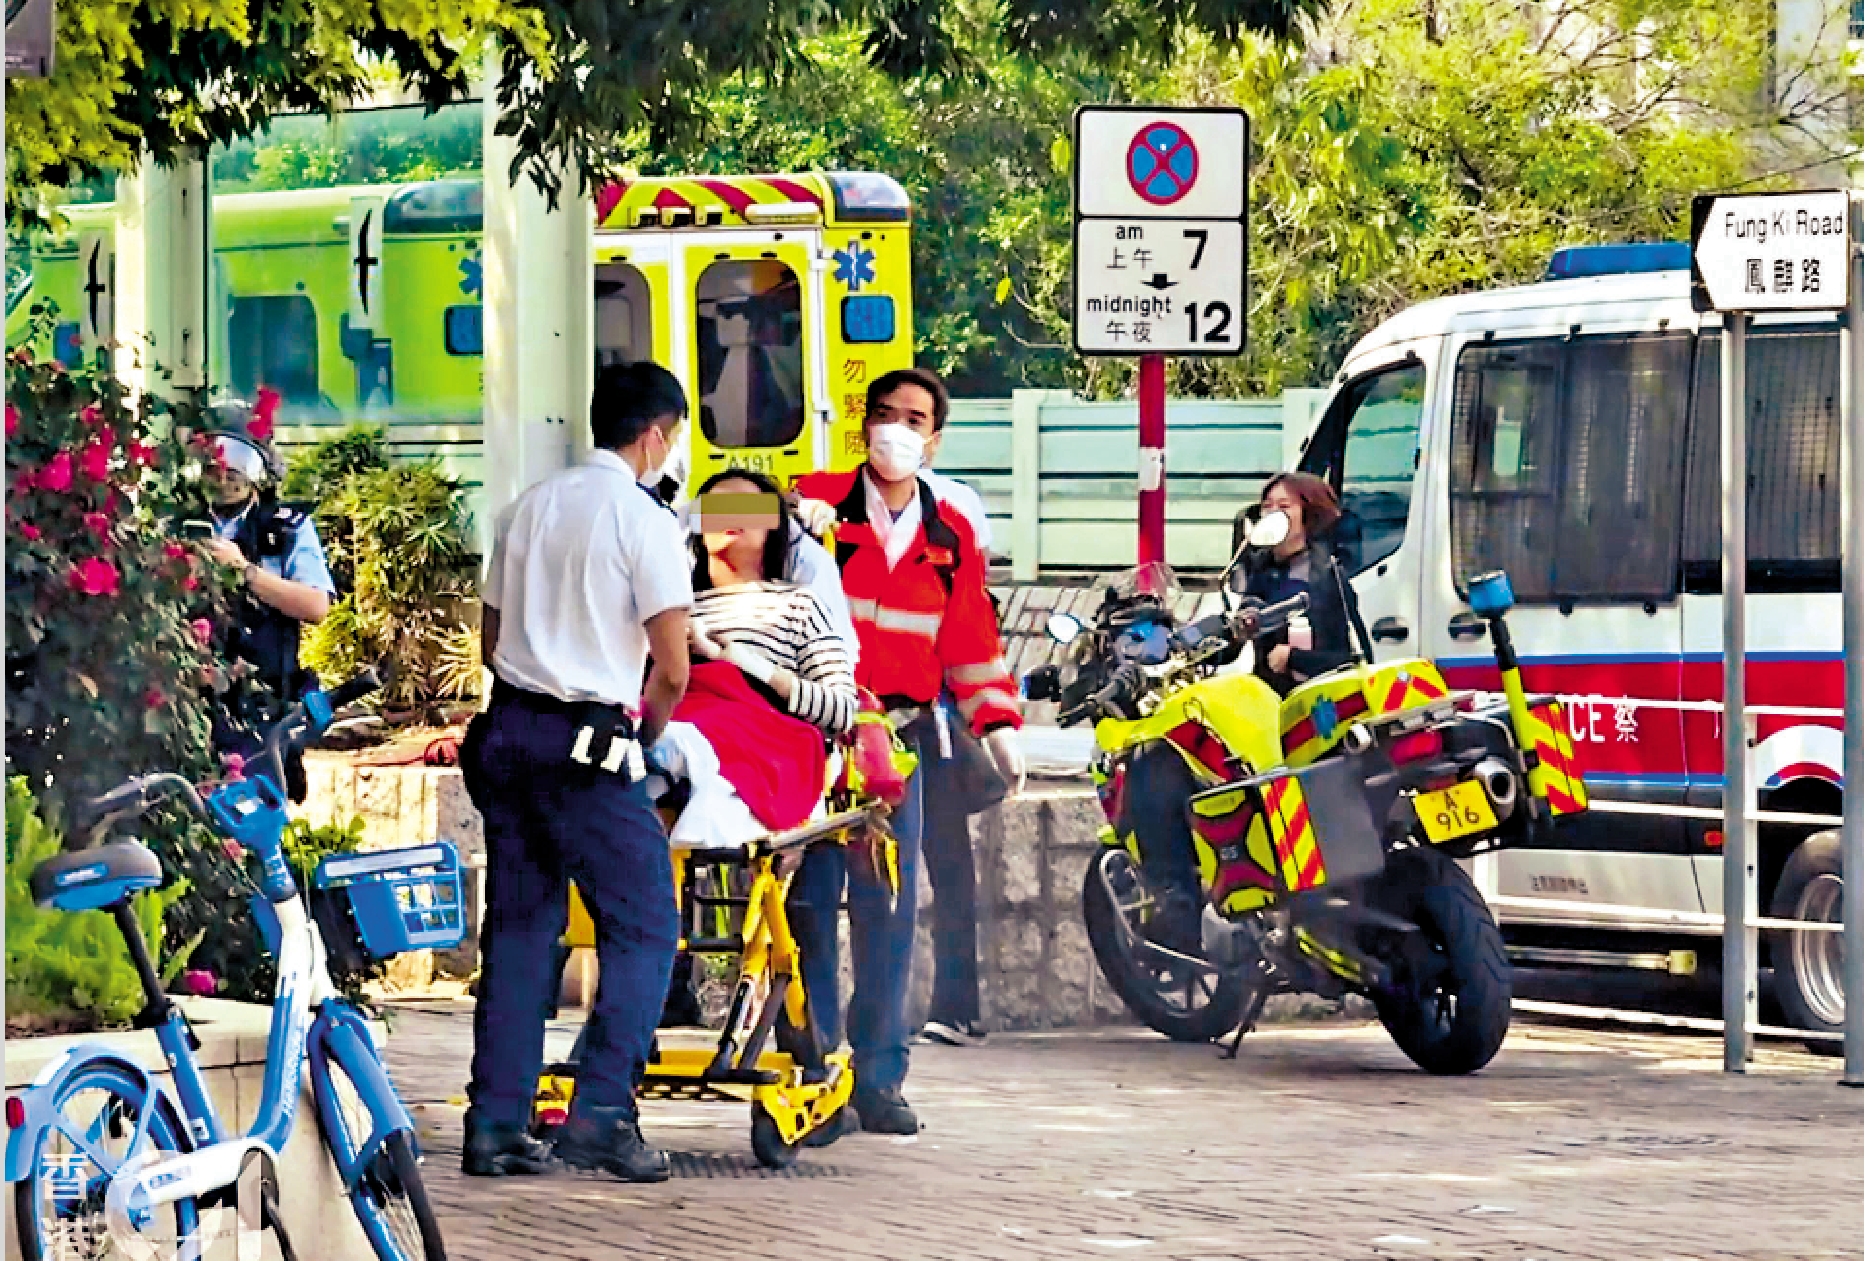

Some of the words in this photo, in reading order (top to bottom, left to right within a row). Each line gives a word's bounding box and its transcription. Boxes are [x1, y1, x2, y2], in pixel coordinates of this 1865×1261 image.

[1115, 224, 1144, 240] am
[1725, 211, 1768, 244] Fung
[1772, 210, 1791, 236] Ki
[1796, 209, 1843, 236] Road
[1106, 246, 1153, 270] 上午
[1183, 228, 1209, 270] 7
[1086, 295, 1172, 318] midnight
[1105, 319, 1152, 343] 午夜
[1184, 300, 1232, 343] 12
[729, 454, 774, 473] A191
[1436, 805, 1481, 832] 916
